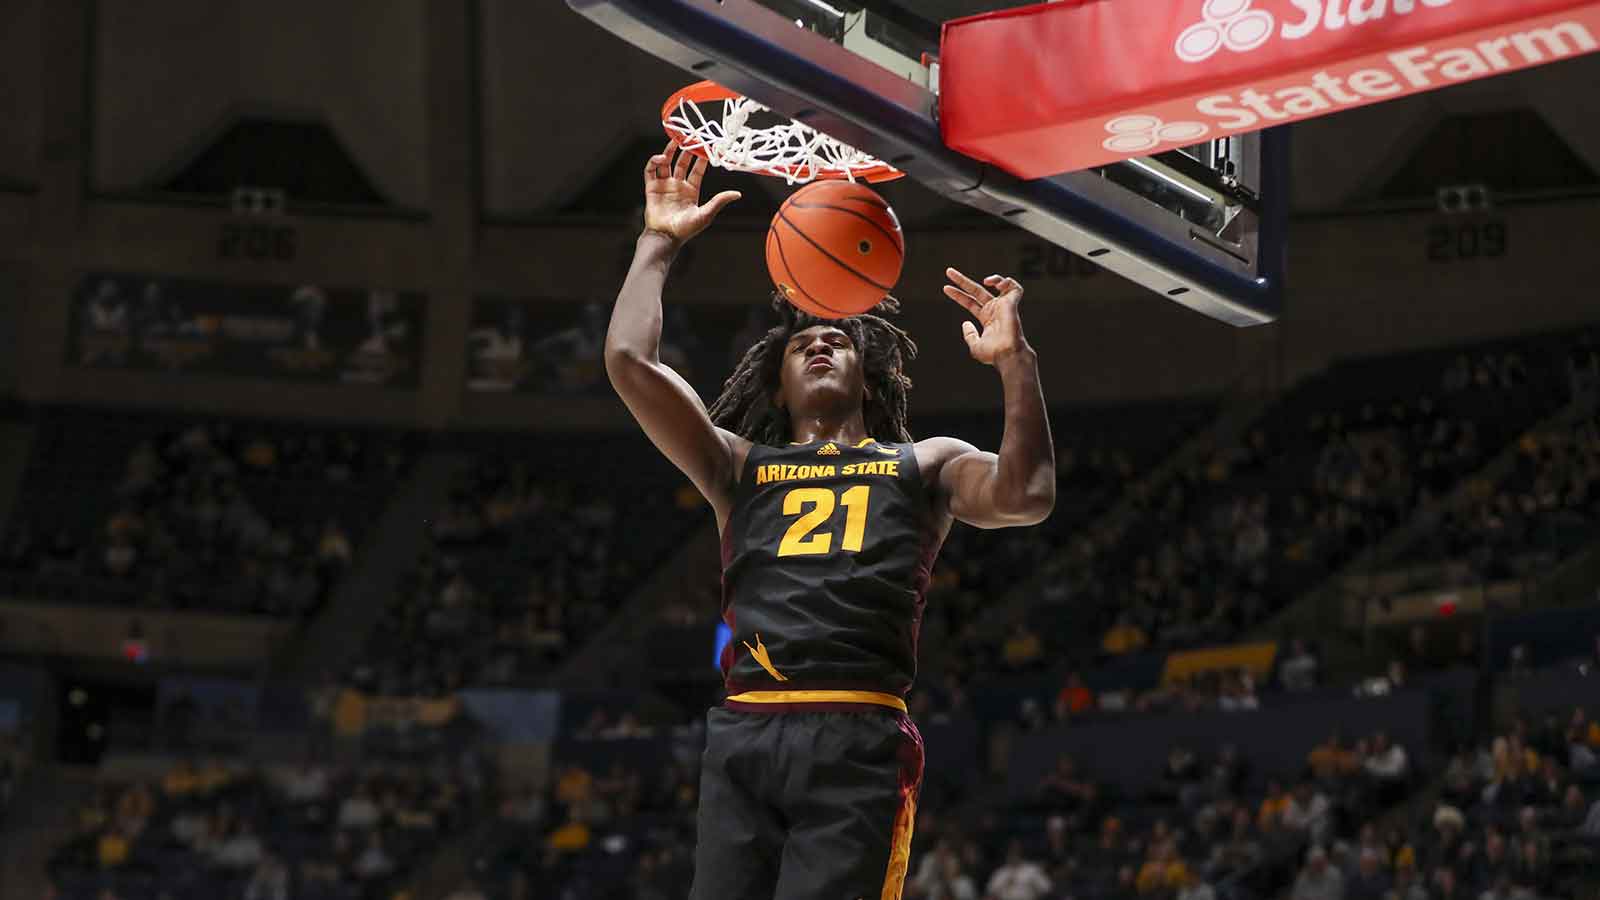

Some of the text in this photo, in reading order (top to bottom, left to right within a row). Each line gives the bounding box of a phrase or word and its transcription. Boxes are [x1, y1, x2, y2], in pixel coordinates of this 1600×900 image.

[1280, 0, 1452, 39] Sta
[1425, 222, 1507, 260] 209
[816, 448, 841, 456] adidas
[755, 460, 899, 486] ARIZONA STATE
[777, 485, 871, 557] 21
